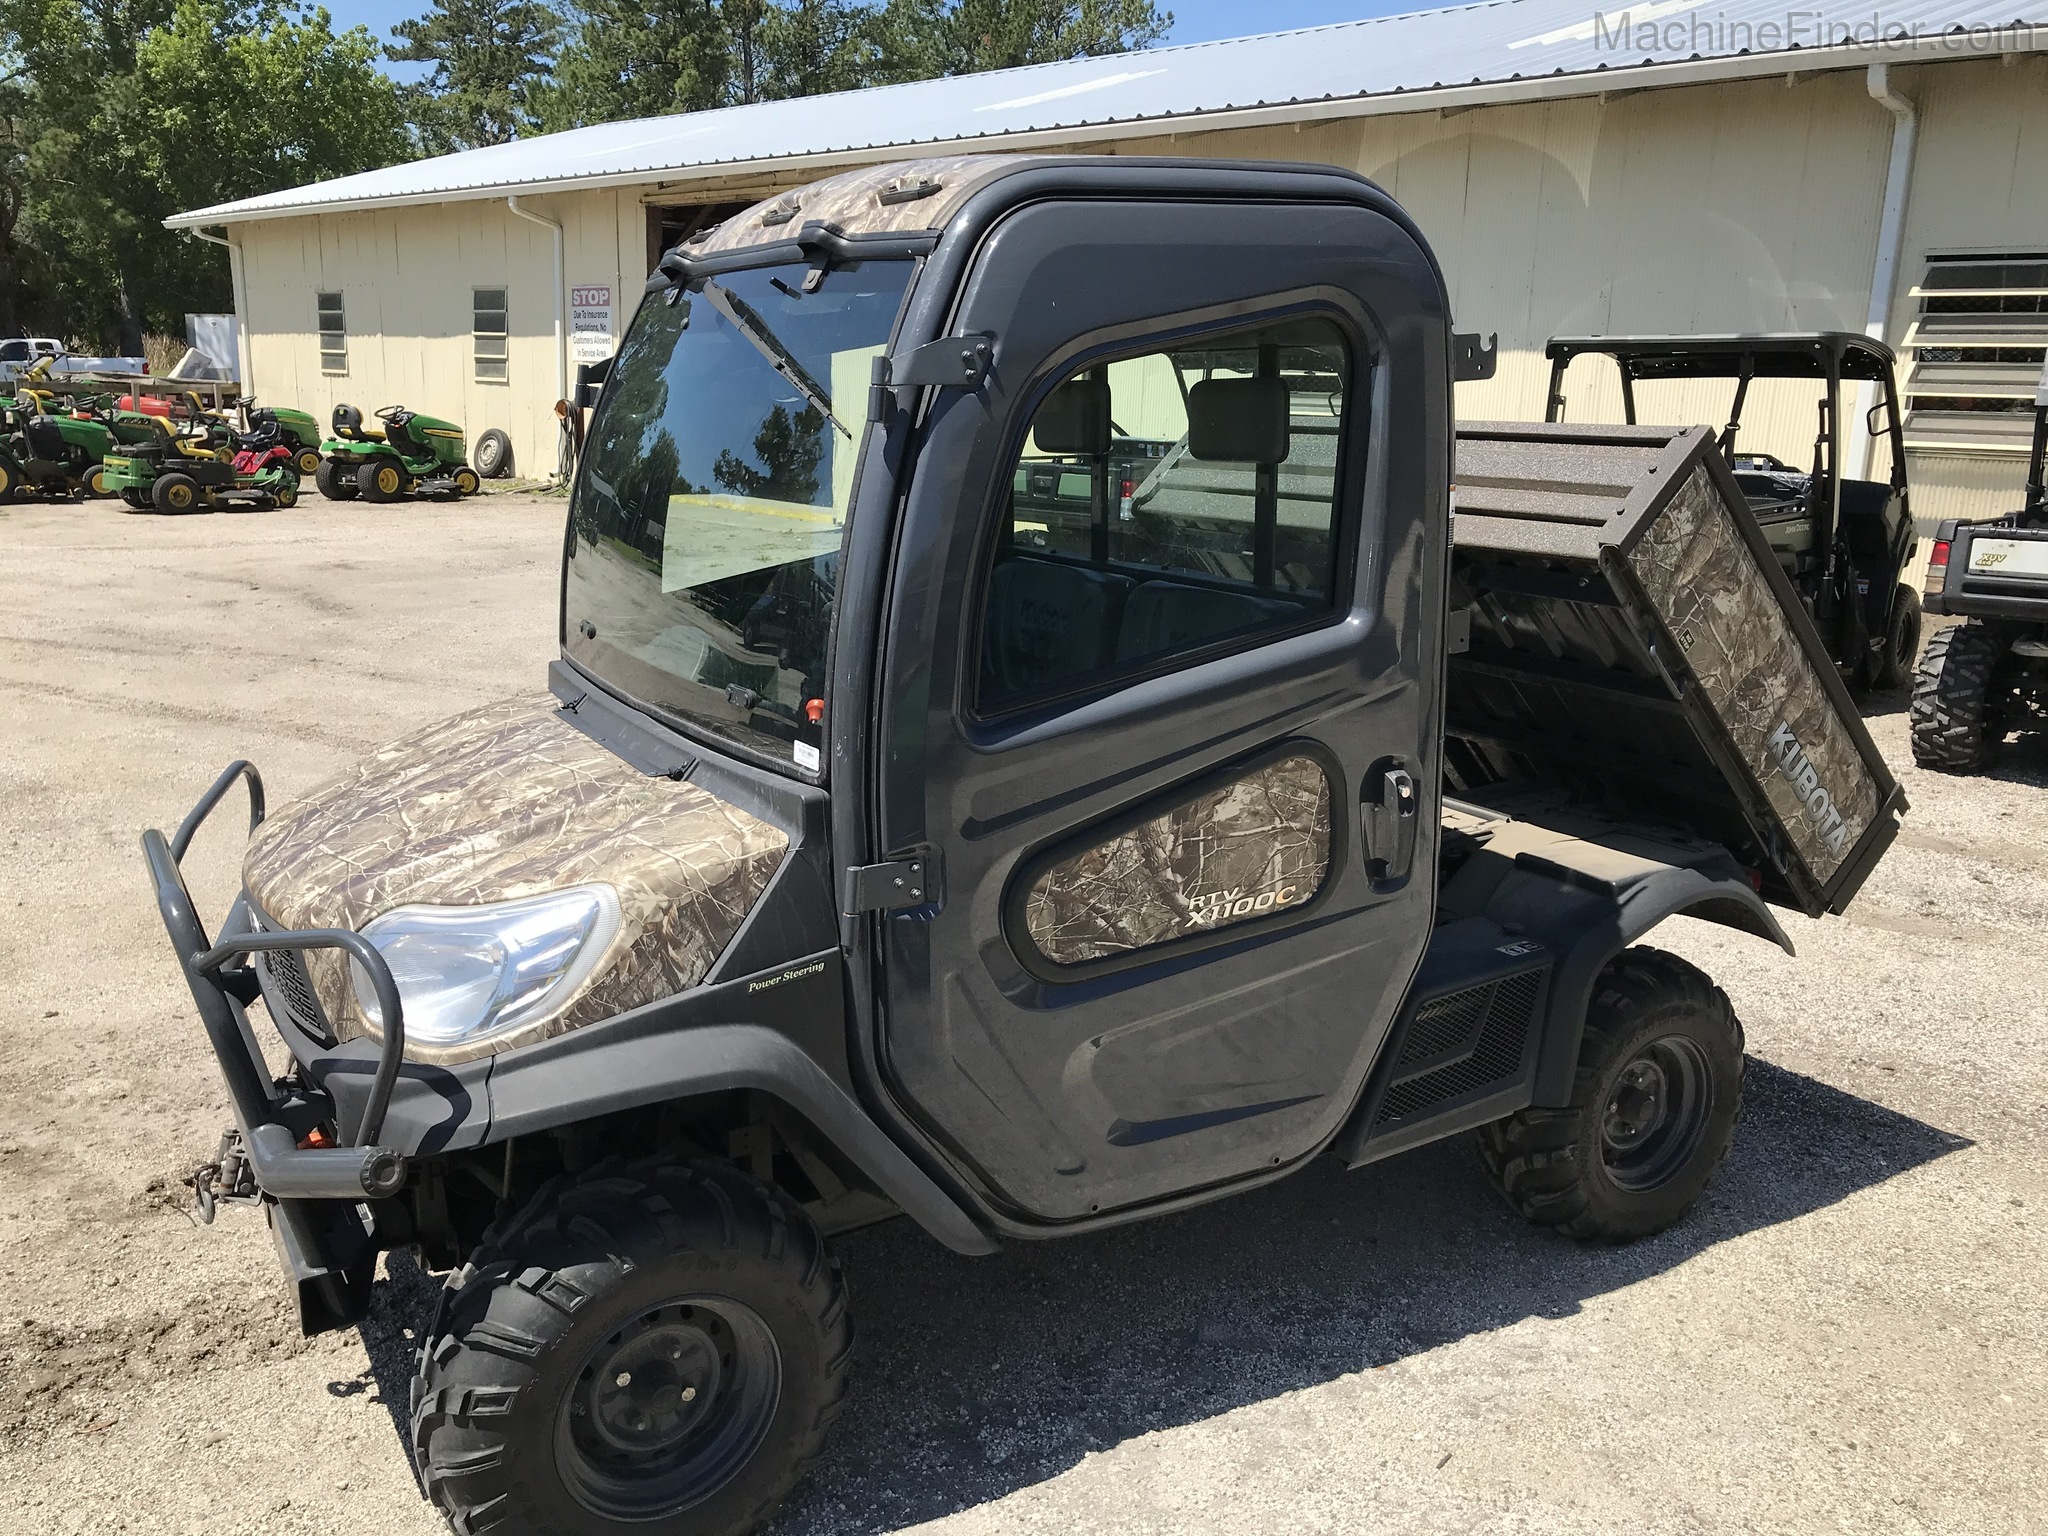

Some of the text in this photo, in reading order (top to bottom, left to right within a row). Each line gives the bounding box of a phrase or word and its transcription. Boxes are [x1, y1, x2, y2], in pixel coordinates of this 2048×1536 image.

[573, 290, 609, 305] STOP
[582, 310, 587, 318] To
[587, 310, 608, 319] Insurance
[575, 323, 607, 333] Regulations, No
[573, 336, 611, 344] Customers Allowed
[582, 349, 595, 357] Service
[1982, 553, 2008, 563] XUV
[1685, 633, 1692, 643] NO
[1767, 719, 1850, 852] KUBOTA
[1188, 887, 1240, 910] RTV
[1184, 885, 1297, 928] X1100C
[748, 962, 825, 993] Power Steering
